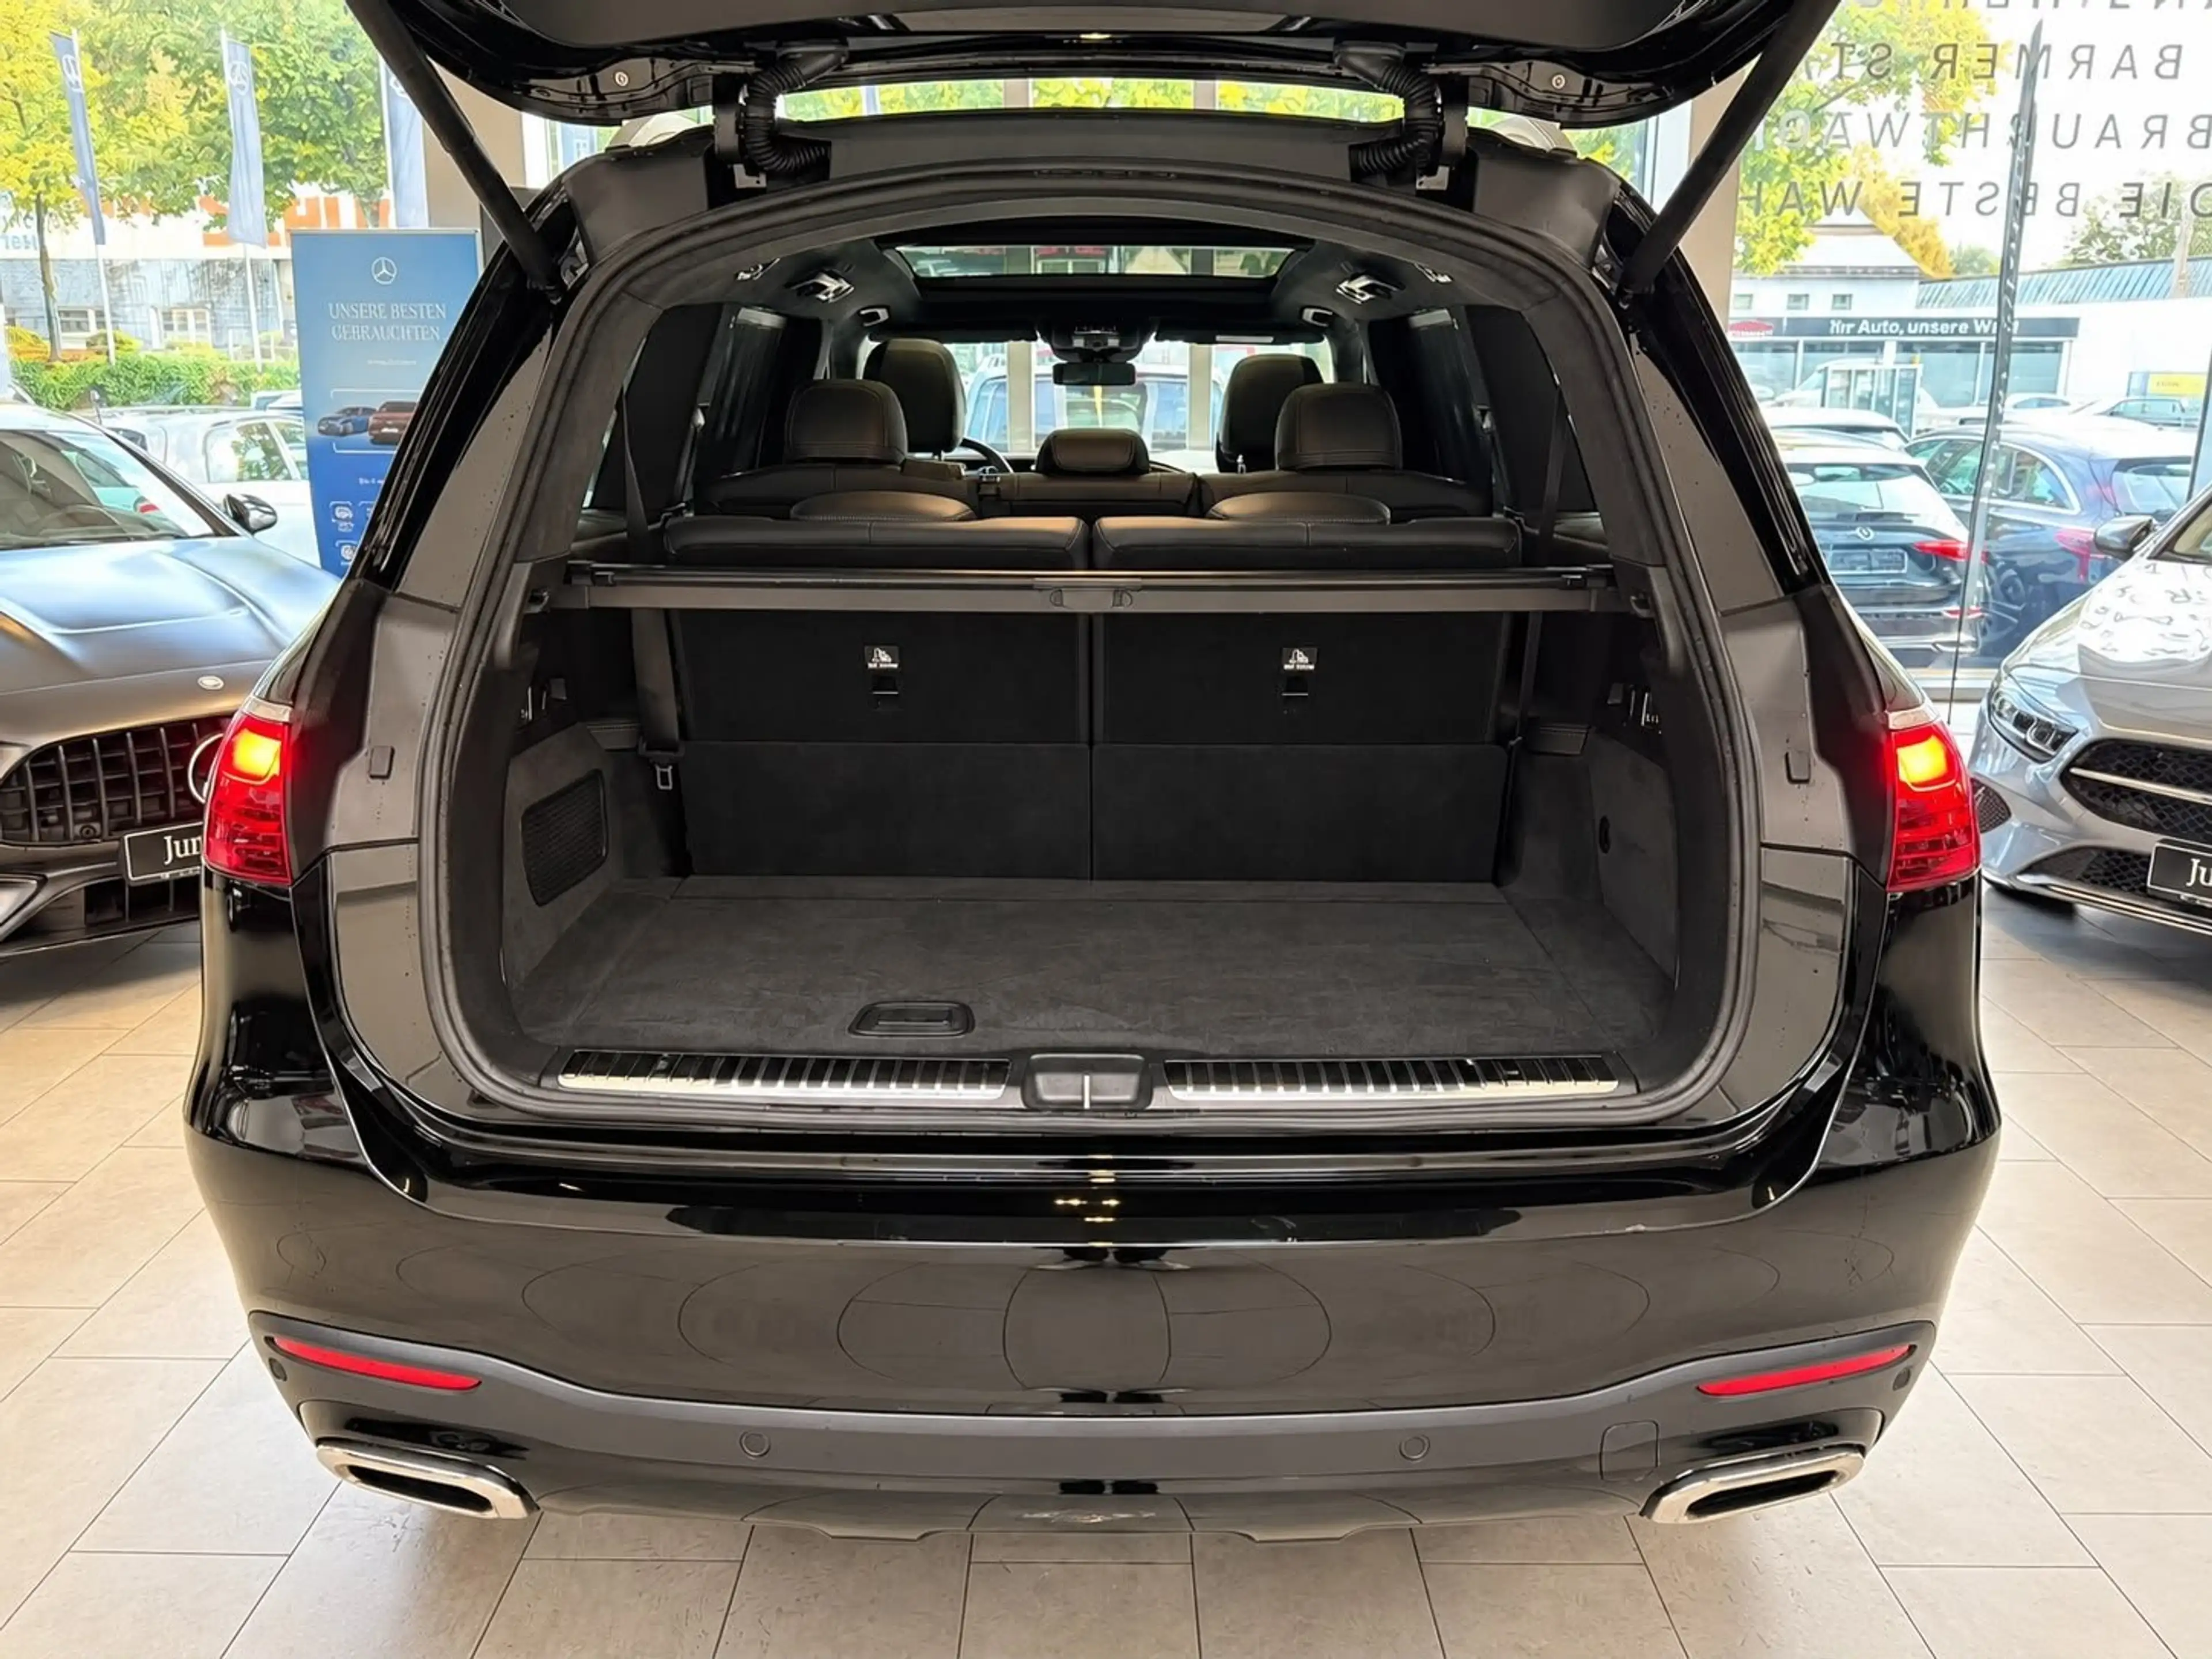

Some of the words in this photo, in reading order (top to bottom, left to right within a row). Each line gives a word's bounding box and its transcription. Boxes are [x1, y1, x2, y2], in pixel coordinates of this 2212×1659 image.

[328, 302, 388, 319] UNSERE
[391, 302, 446, 320] BESTEN
[1857, 319, 1904, 335] Auto,
[1907, 320, 1969, 334] unsere
